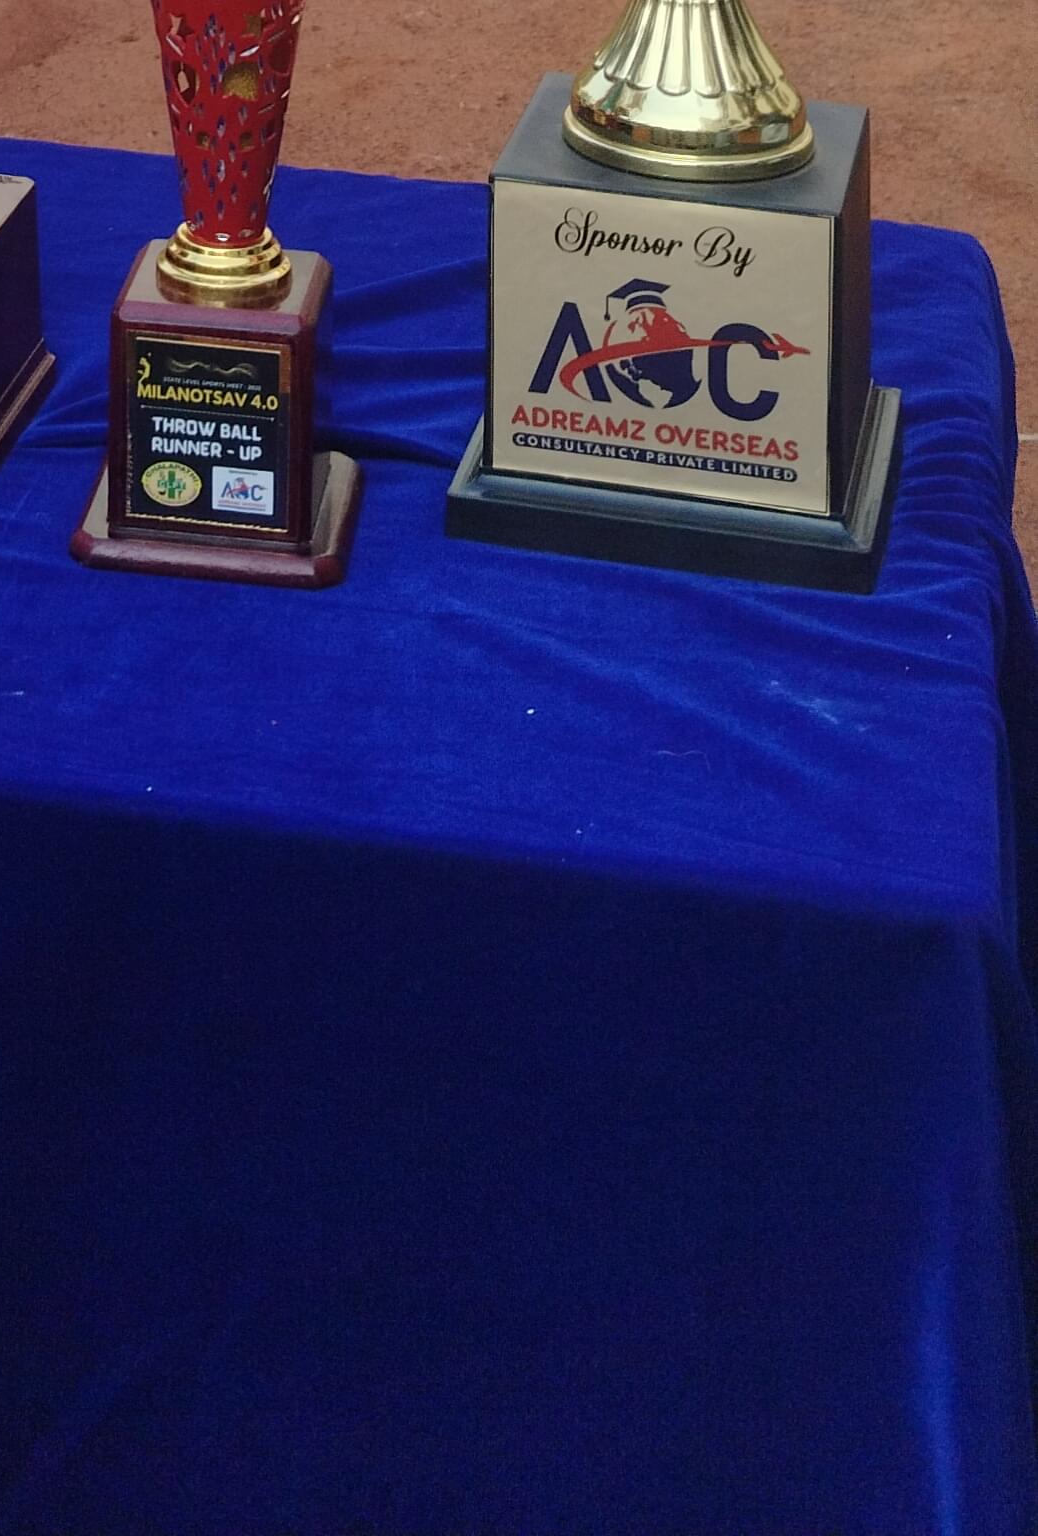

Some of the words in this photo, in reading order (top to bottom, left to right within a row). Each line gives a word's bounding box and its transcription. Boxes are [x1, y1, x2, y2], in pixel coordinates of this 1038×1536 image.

[554, 207, 683, 257] Sponsor
[693, 226, 757, 278] By
[137, 383, 247, 408] MILANOTSAV
[250, 394, 279, 411] 4.0
[152, 416, 216, 438] THROW
[219, 423, 262, 442] BALL
[511, 404, 646, 441] ADREAMZ
[654, 423, 800, 463] OVERSEAS
[151, 436, 222, 458] RUNNER
[239, 445, 262, 461] UP
[515, 433, 640, 461] CONSULTANCY
[646, 451, 715, 470] PRIVATE
[721, 460, 794, 481] LIMITED
